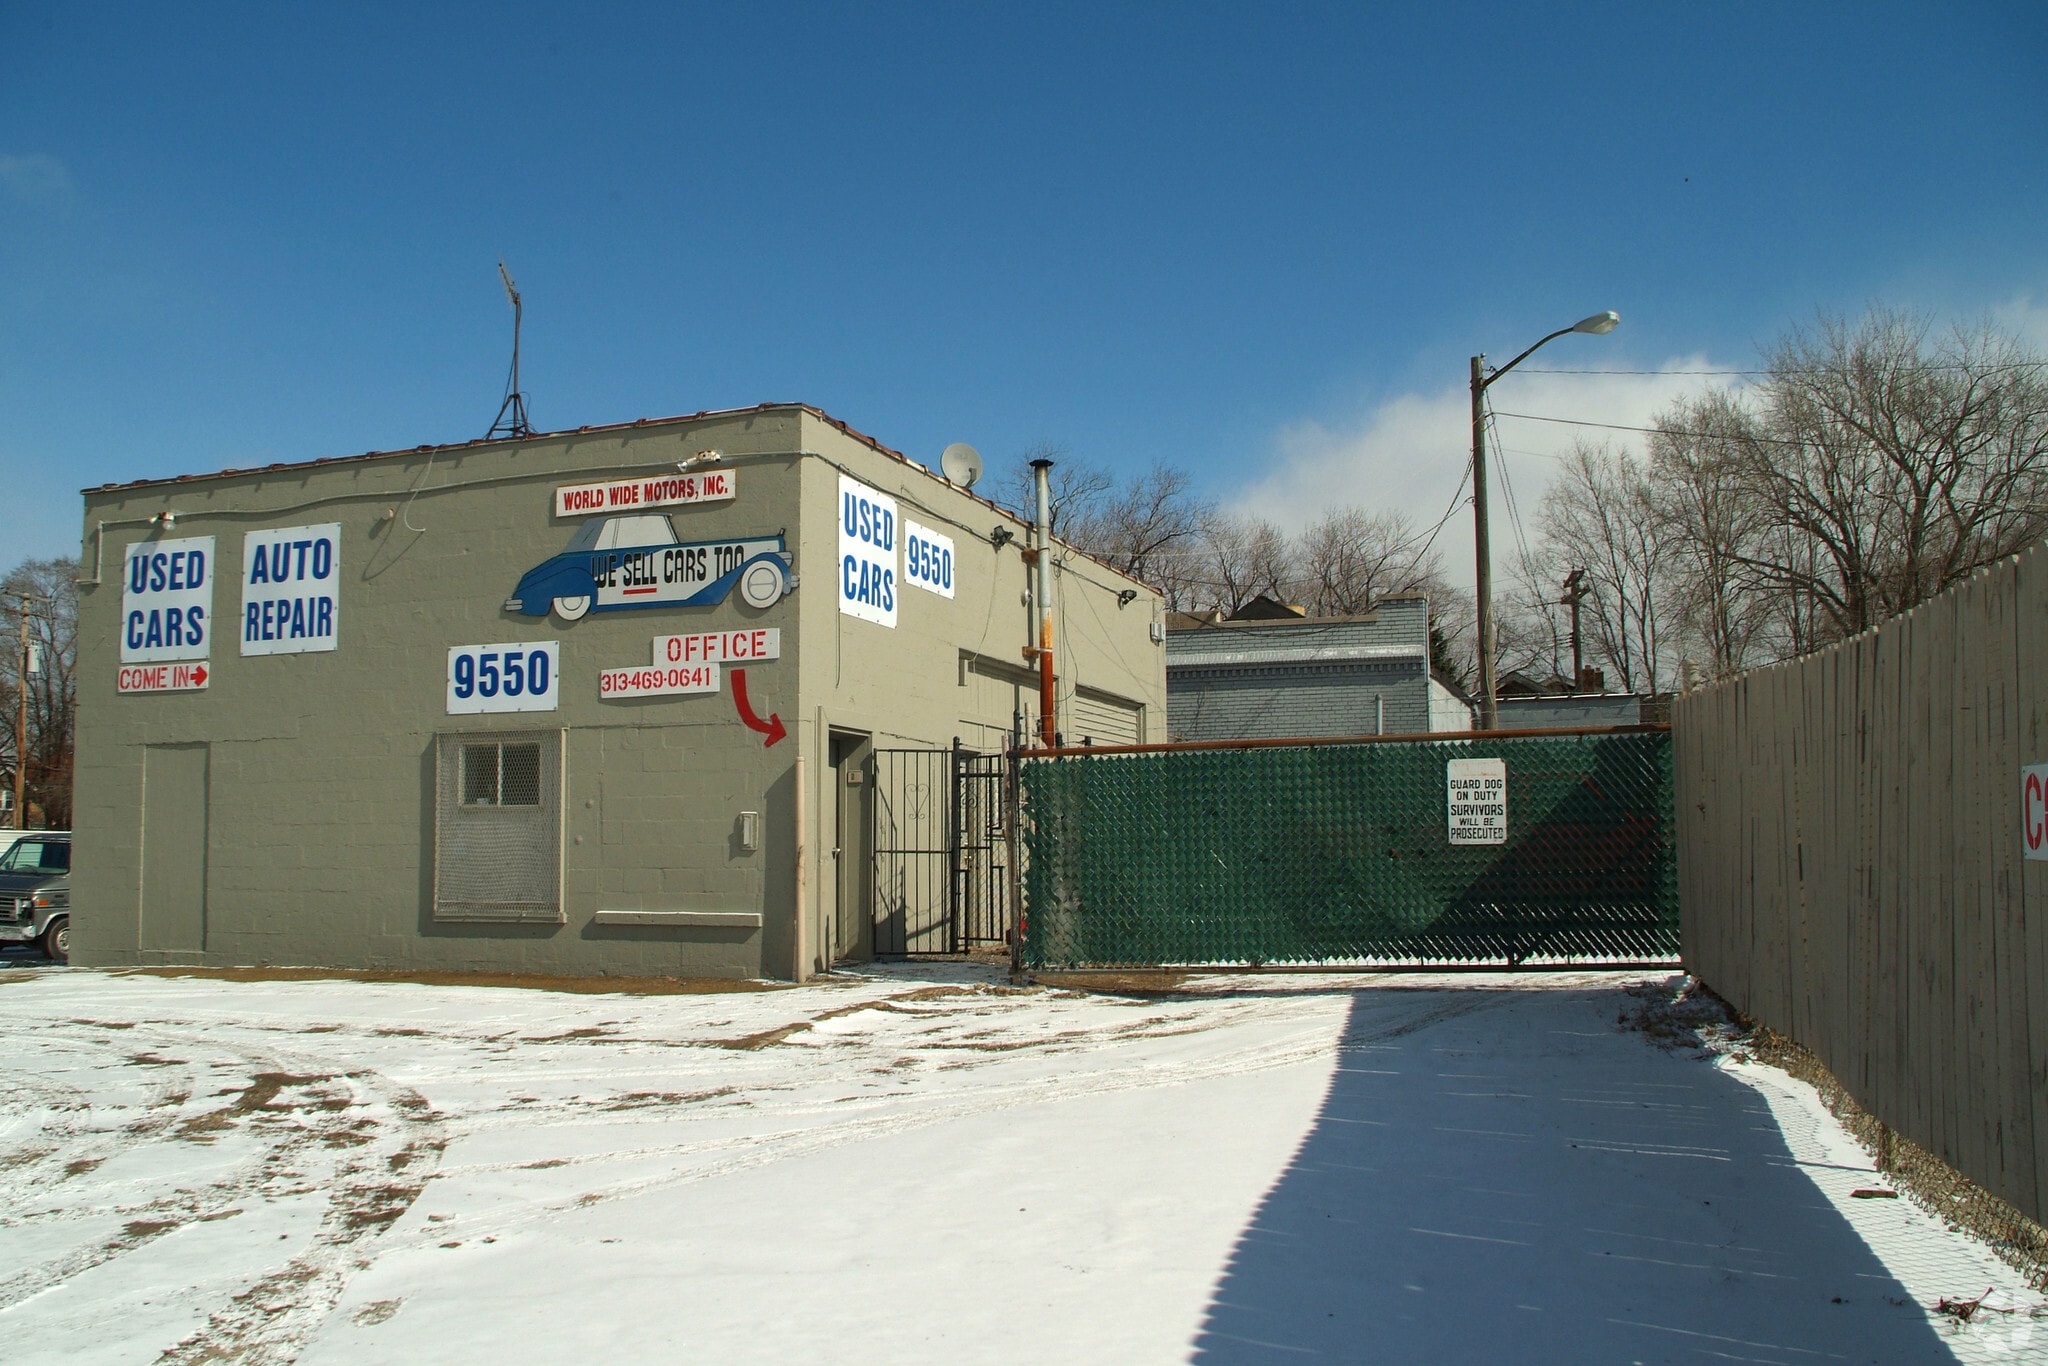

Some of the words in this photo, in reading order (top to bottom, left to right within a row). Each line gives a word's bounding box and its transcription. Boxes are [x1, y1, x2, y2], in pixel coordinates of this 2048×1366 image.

[564, 488, 604, 511] WORLD
[609, 485, 639, 506] WIDE
[644, 478, 699, 502] MOTORS,
[703, 474, 728, 496] INC.
[844, 491, 893, 552] USED
[131, 550, 205, 594] USED
[250, 538, 332, 585] AUTO
[591, 554, 617, 588] WE
[623, 552, 657, 587] SELL
[663, 547, 707, 584] CARS
[908, 534, 951, 589] 9550
[843, 554, 893, 612] CARS
[127, 605, 204, 649] CARS
[246, 596, 333, 642] REPAIR
[667, 631, 767, 662] OFFICE
[119, 667, 168, 690] COME
[173, 665, 190, 688] IN
[454, 650, 549, 698] 9550
[1450, 779, 1480, 789] GUARD
[1485, 779, 1502, 789] DOG
[1456, 791, 1468, 801] ON
[1474, 791, 1497, 801] DUTY
[1450, 804, 1503, 816] SURVIVORS
[1459, 818, 1479, 826] WILL
[1483, 817, 1494, 826] BE
[2025, 772, 2048, 850] C
[1450, 827, 1503, 839] PROSECUTED
